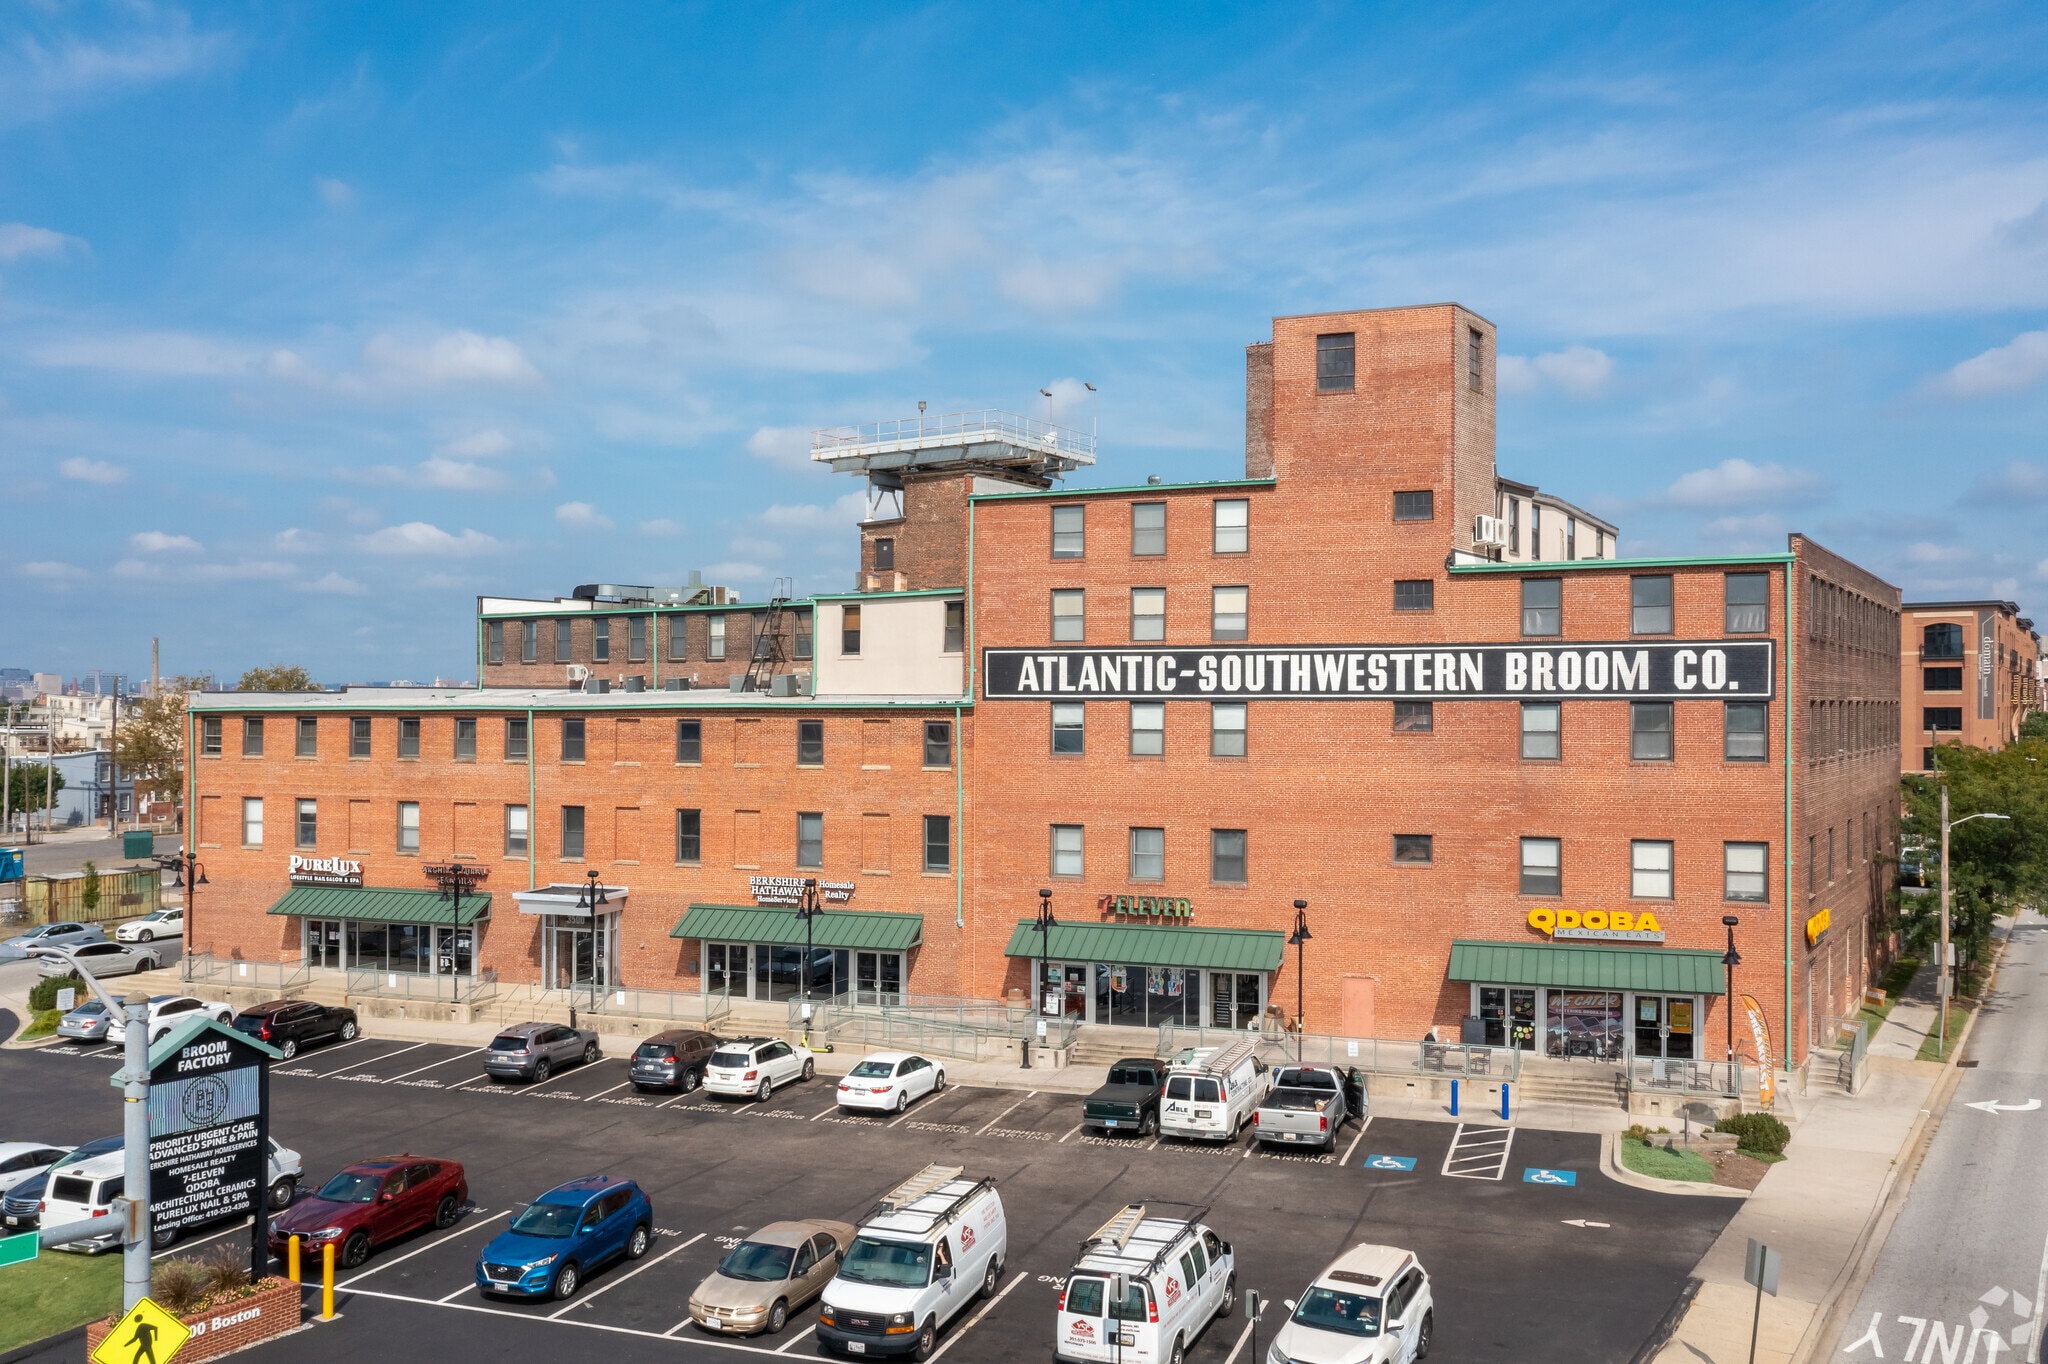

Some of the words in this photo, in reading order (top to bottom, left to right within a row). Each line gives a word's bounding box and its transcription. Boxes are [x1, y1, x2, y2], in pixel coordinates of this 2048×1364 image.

[1018, 653, 1483, 692] ATLANTIC-SOUTHWESTERN
[1506, 650, 1648, 691] BROOM
[1673, 649, 1739, 690] CO.
[750, 876, 806, 887] BERKSHIRE
[819, 880, 855, 890] Homesale
[752, 886, 805, 896] HATHAWAY
[757, 896, 798, 904] HomeServices
[824, 890, 850, 900] Realty
[1527, 907, 1661, 935] QDOBA
[1550, 994, 1570, 1006] WE
[1574, 994, 1618, 1007] CATER
[182, 1040, 228, 1058] BROOM
[178, 1052, 232, 1072] FACTORY
[745, 1110, 806, 1120] PARKING
[822, 1118, 884, 1127] PARKING
[150, 1135, 192, 1152] PRIORITY
[194, 1126, 230, 1142] URGENT
[232, 1121, 255, 1134] CARE
[201, 1136, 228, 1150] SPINE
[238, 1129, 258, 1141] PAIN
[150, 1158, 178, 1170] ERKSHIRE
[180, 1150, 214, 1164] HATHAWAY
[214, 1140, 258, 1155] HOMESERVICES
[1260, 1154, 1332, 1164] PARKING
[169, 1161, 208, 1176] HOMESALE
[210, 1154, 236, 1167] REALTY
[183, 1166, 224, 1184] 7-ELEVEN
[186, 1178, 220, 1194] QDOBA
[150, 1190, 214, 1213] ARCHITECTURAL
[216, 1178, 256, 1196] CERAMICS
[157, 1204, 198, 1222] PURELUX
[200, 1198, 222, 1211] NAIL
[223, 1196, 230, 1204] &
[232, 1192, 248, 1202] SPA
[154, 1220, 180, 1232] Leasing
[182, 1213, 204, 1224] Office:
[206, 1201, 250, 1218] 410-522-4300
[212, 1308, 260, 1332] Boston
